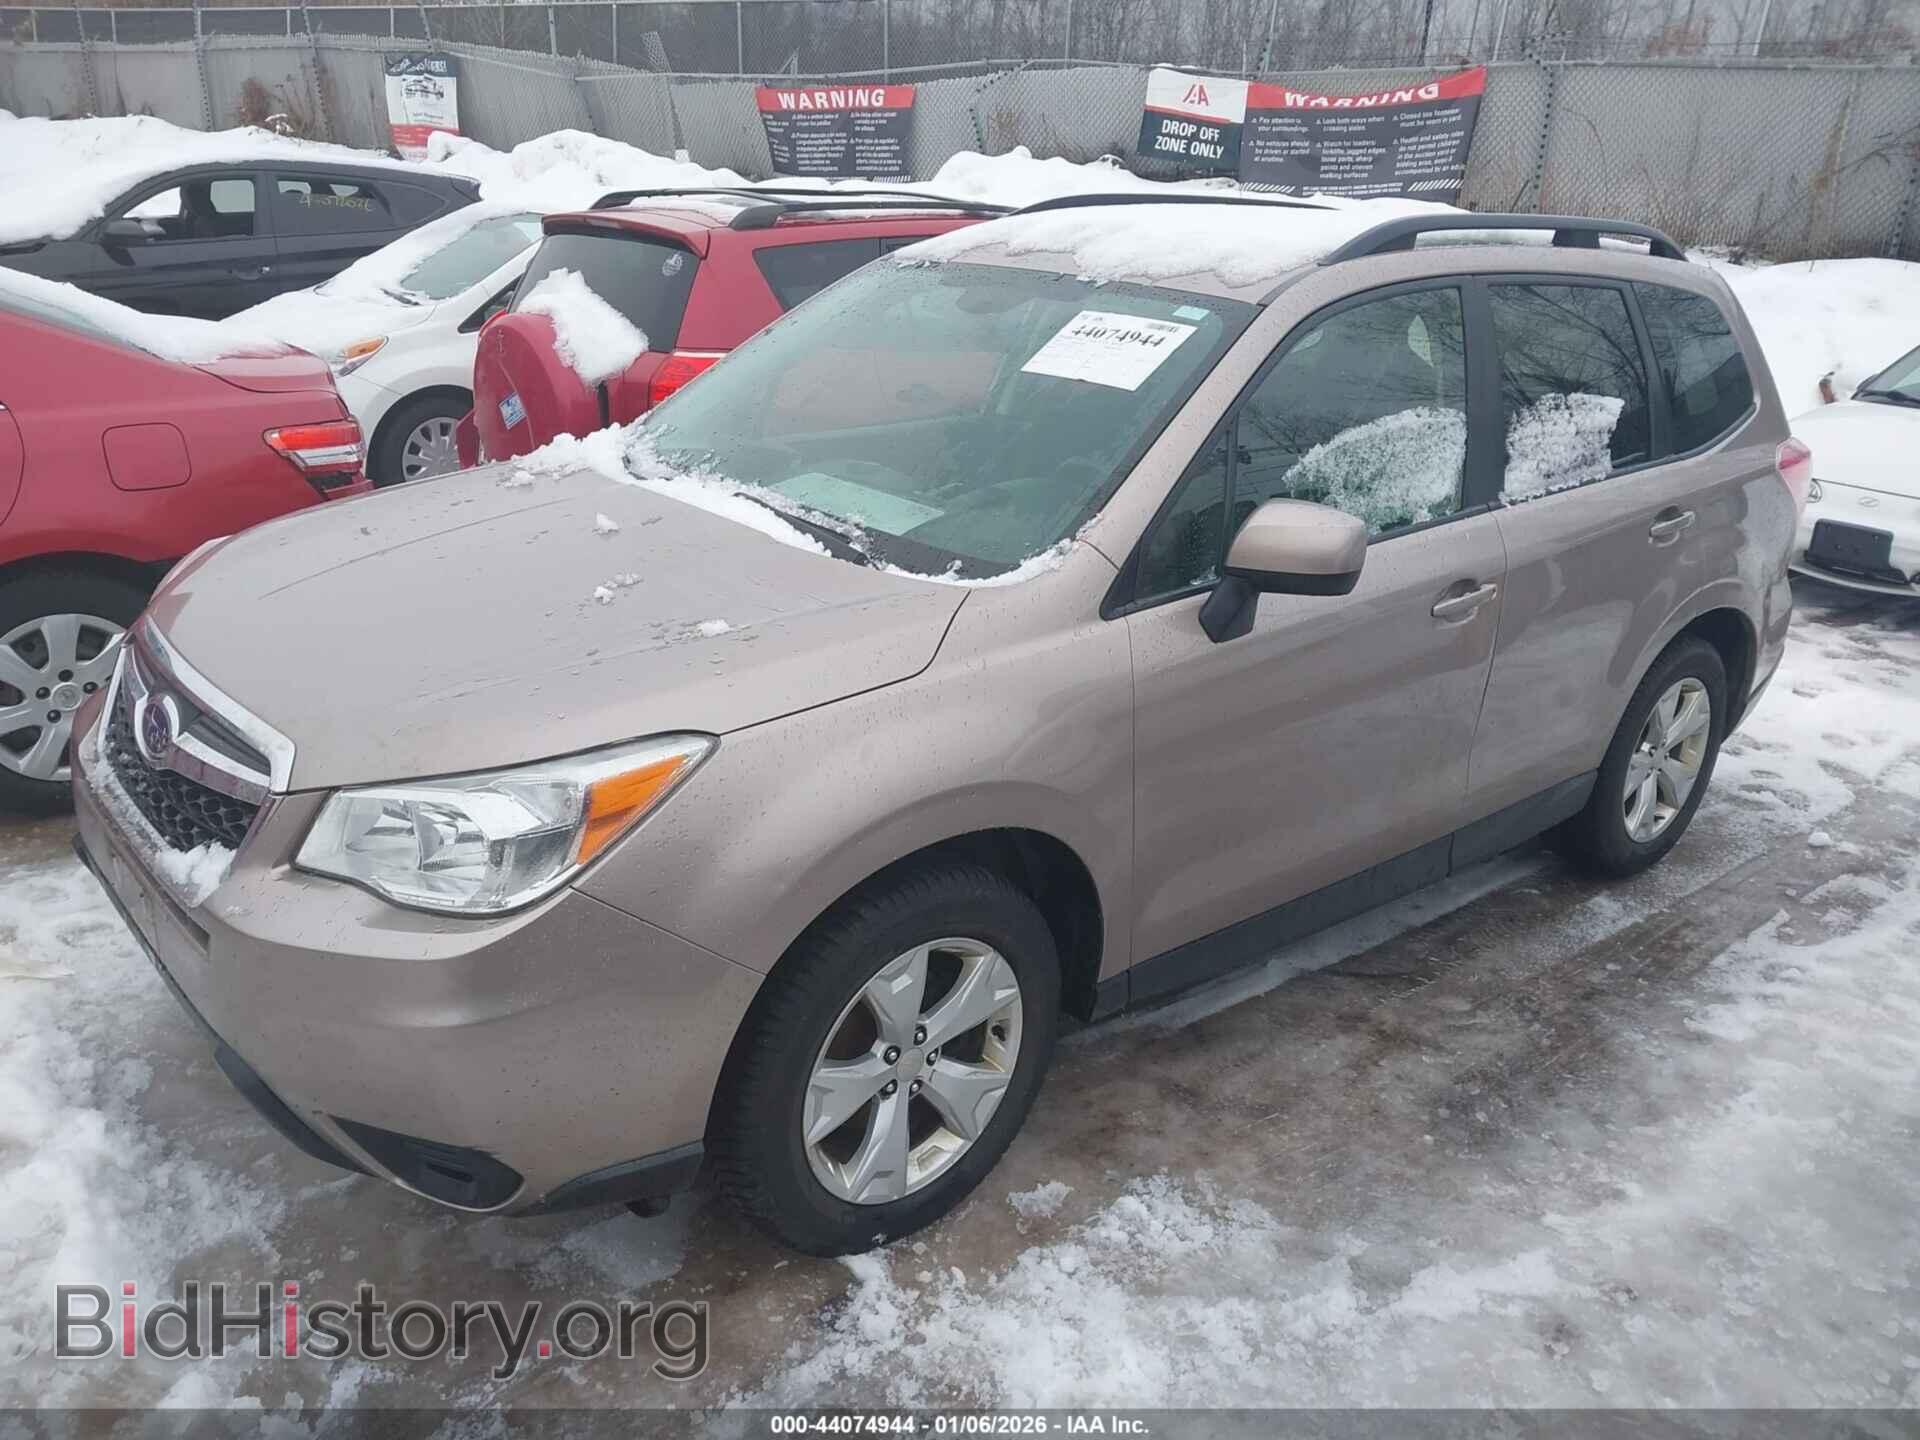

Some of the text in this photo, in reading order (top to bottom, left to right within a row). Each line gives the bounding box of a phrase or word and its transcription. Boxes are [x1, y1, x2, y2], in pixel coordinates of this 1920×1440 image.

[777, 88, 885, 110] WARNING
[1284, 83, 1440, 107] WARNING
[1161, 119, 1220, 142] DROP OFF
[1154, 135, 1224, 159] ZONE ONLY
[1071, 324, 1166, 347] 44074944
